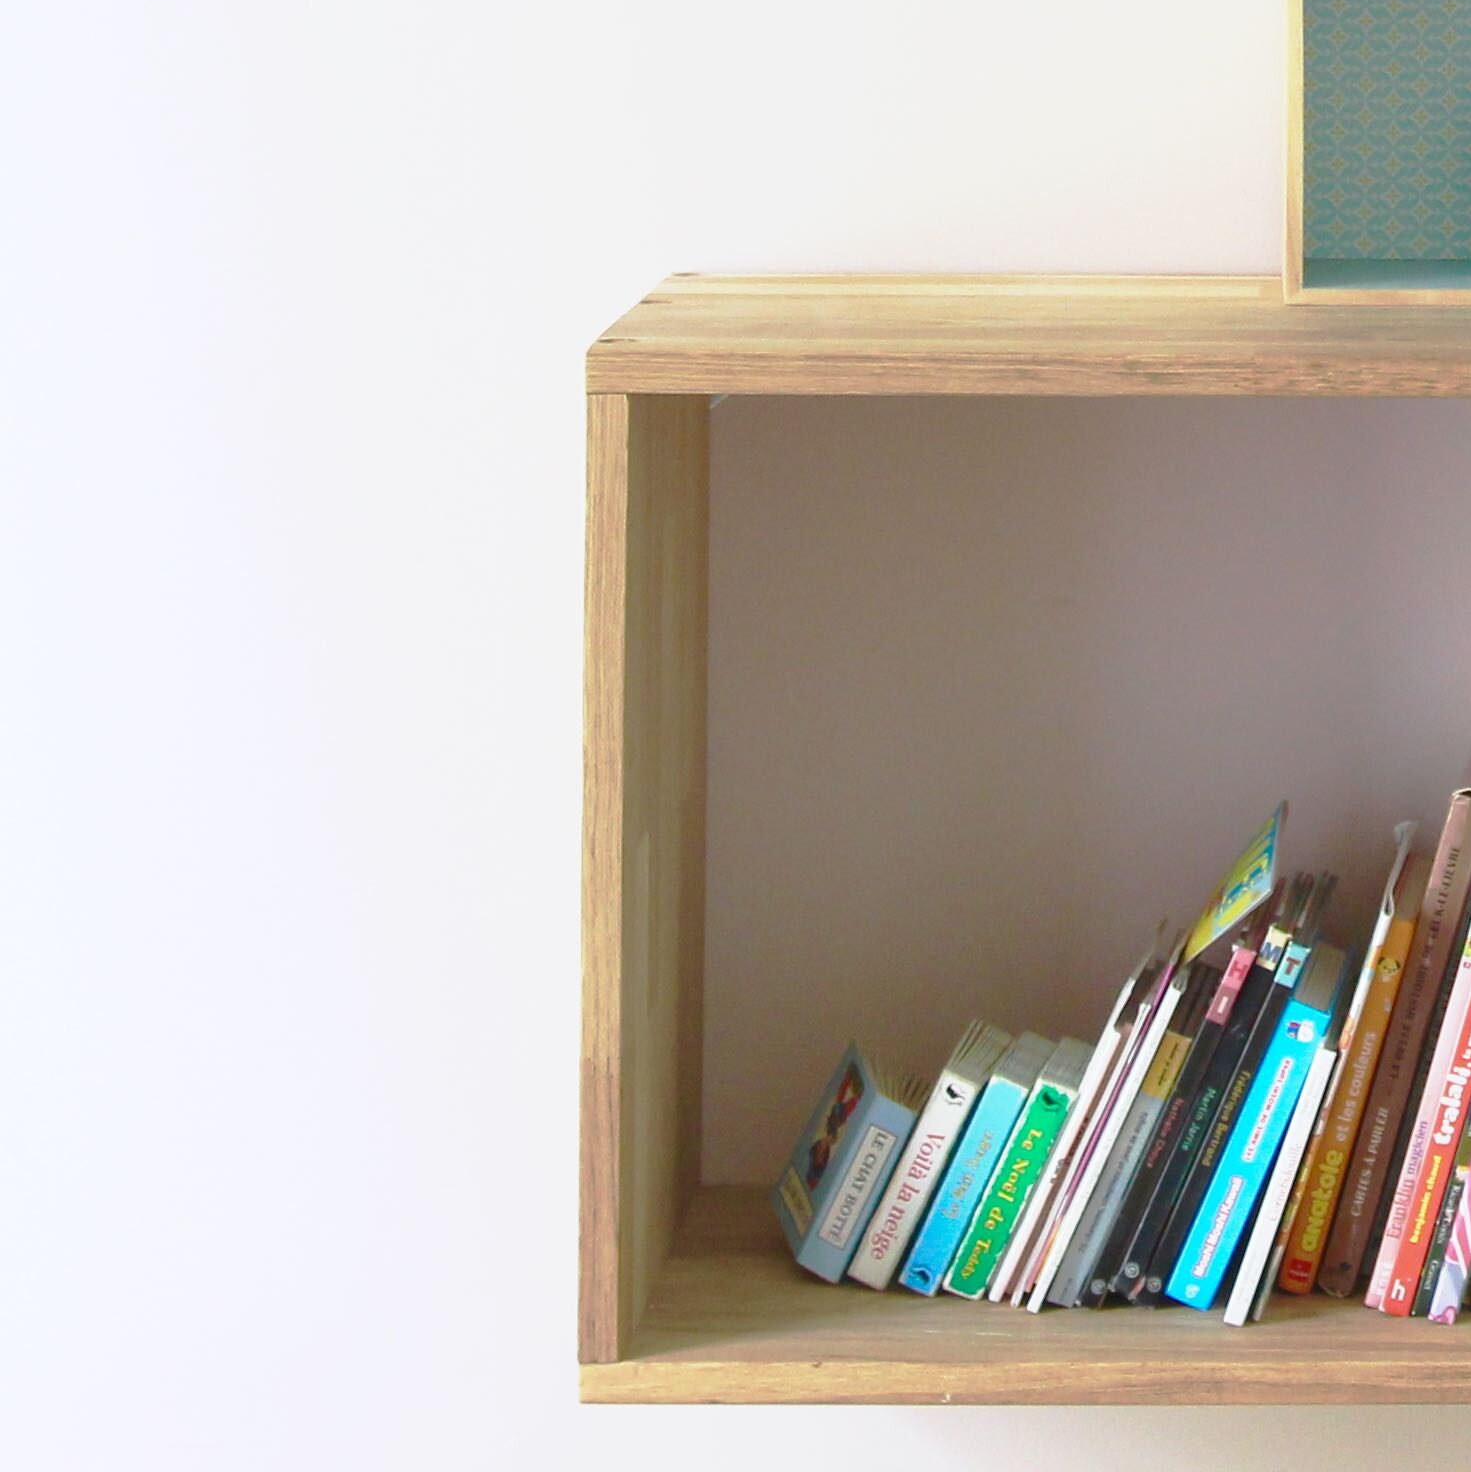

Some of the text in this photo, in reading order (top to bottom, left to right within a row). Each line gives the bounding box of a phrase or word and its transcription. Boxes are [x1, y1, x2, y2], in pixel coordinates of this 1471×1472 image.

[1344, 1030, 1378, 1097] couleurs
[1158, 1096, 1185, 1137] Nathalie
[1180, 1086, 1217, 1153] Martin Jarrie
[1336, 1123, 1351, 1142] et
[1339, 1098, 1357, 1122] les
[870, 1130, 888, 1152] LE
[1021, 1126, 1043, 1152] Le
[1200, 1121, 1230, 1168] Bertrand
[850, 1152, 878, 1193] CHAT
[865, 1128, 945, 1263] Voilà la neige
[996, 1154, 1032, 1202] Noël
[1384, 1119, 1431, 1240] Franklin magicien
[983, 1205, 1007, 1232] de
[1294, 1146, 1346, 1253] anatole
[1407, 1153, 1444, 1244] benjamin chaud
